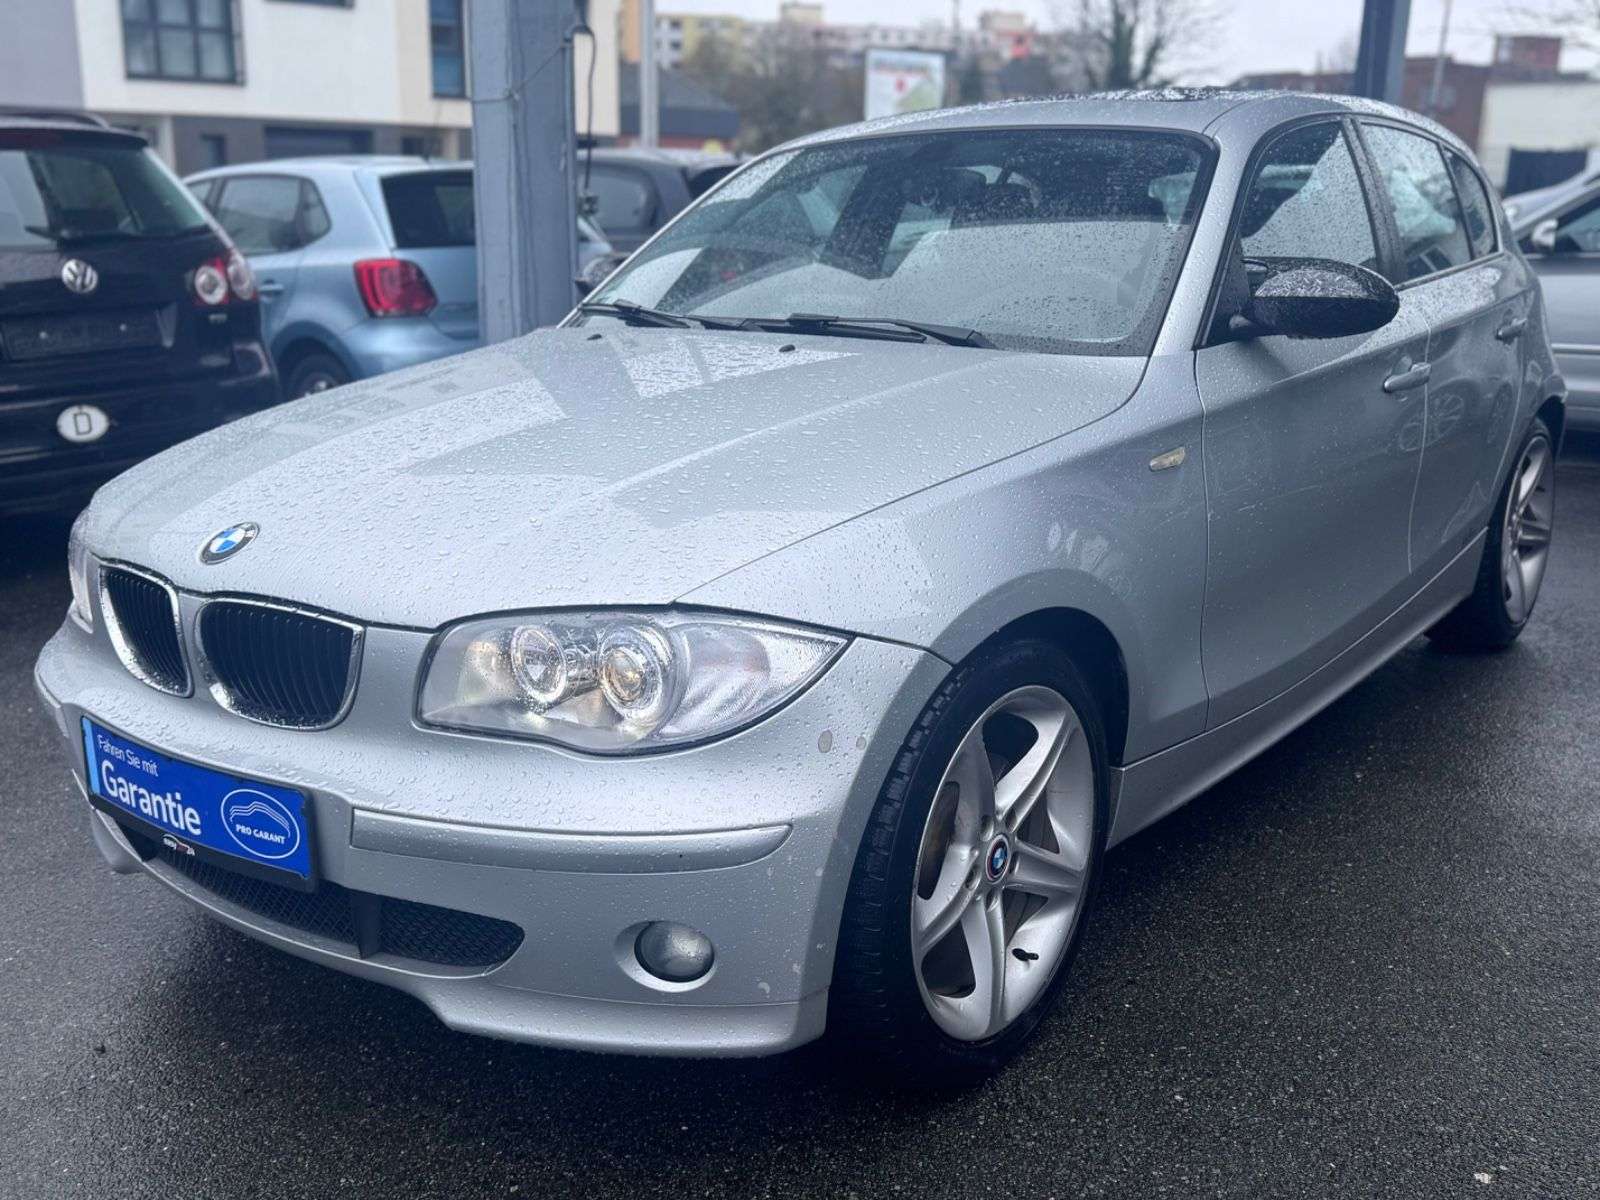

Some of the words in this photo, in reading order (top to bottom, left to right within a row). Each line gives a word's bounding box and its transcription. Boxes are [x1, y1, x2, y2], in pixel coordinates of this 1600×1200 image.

[73, 411, 92, 436] D
[97, 734, 125, 761] Fahren
[125, 749, 141, 769] Sie
[141, 760, 159, 777] mit
[101, 760, 202, 836] Garantie
[235, 824, 252, 836] PRO
[252, 828, 286, 845] GARANT
